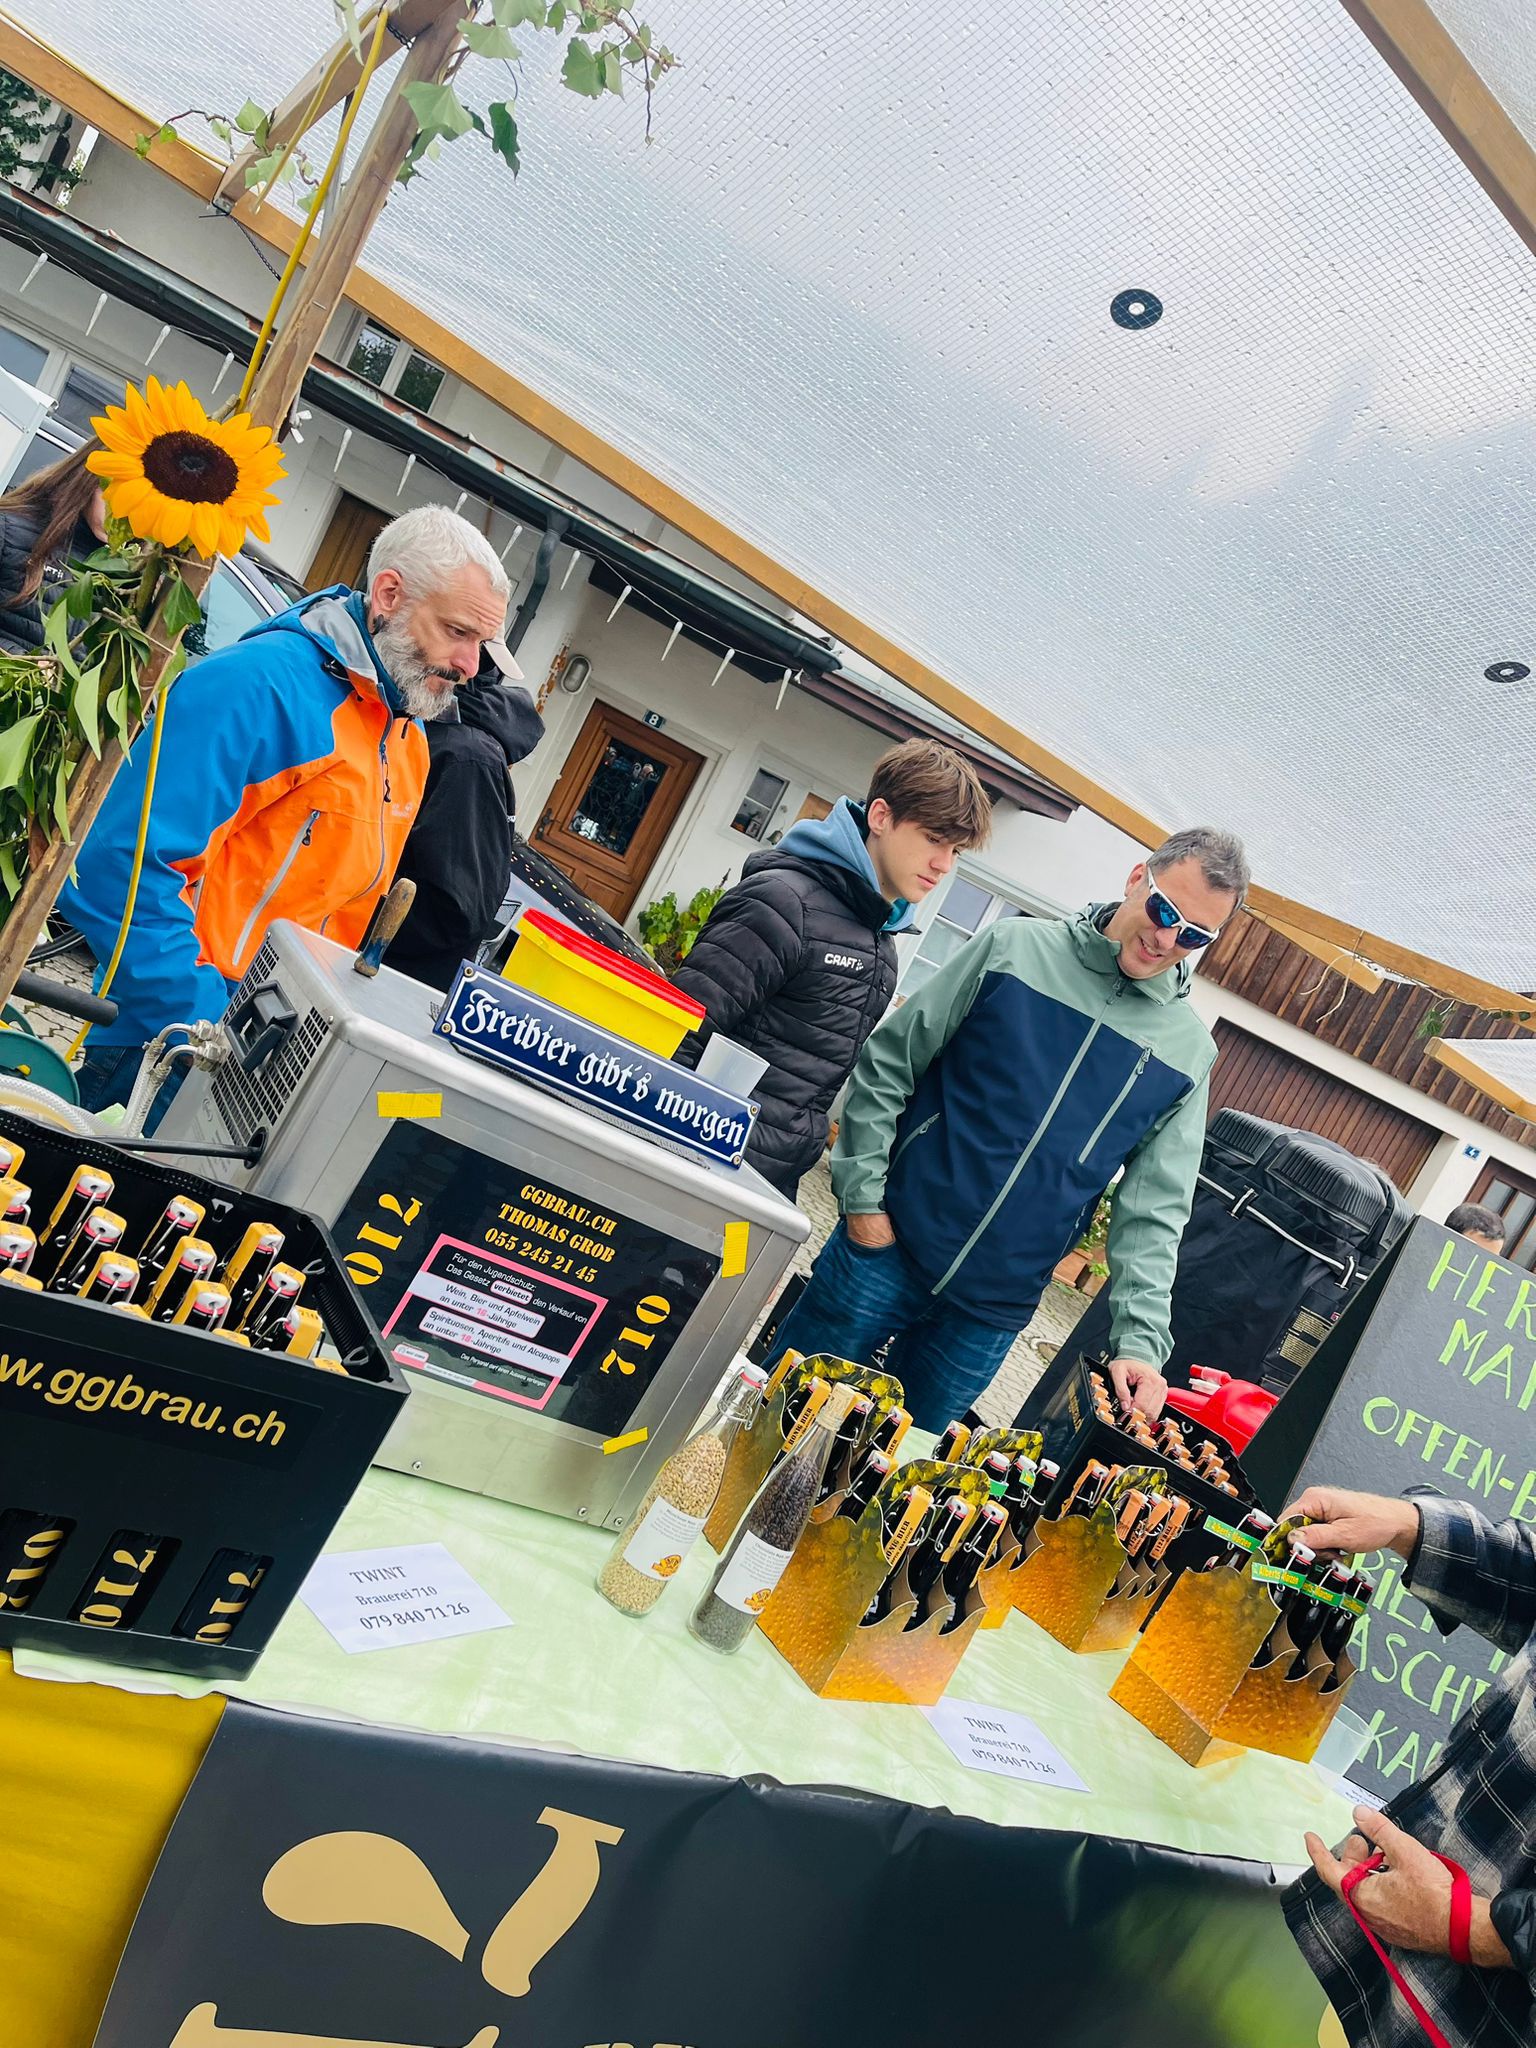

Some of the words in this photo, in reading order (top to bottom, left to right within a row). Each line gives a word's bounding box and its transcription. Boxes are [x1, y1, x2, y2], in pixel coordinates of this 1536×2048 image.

[649, 714, 660, 727] 8
[824, 953, 857, 969] CRAFT
[461, 987, 577, 1067] Freibier
[653, 1087, 746, 1148] morgen
[520, 1184, 618, 1236] GGBRAU.CH
[498, 1203, 571, 1244] THOMAS
[568, 1234, 617, 1264] GROB
[484, 1227, 520, 1251] 055
[518, 1241, 553, 1265] 245
[551, 1254, 575, 1275] 21
[575, 1265, 599, 1284] 45
[452, 1252, 468, 1264] Für
[467, 1259, 483, 1271] den
[483, 1265, 537, 1293] Jugendschutz:
[440, 1296, 451, 1304] an
[450, 1299, 474, 1312] unter
[445, 1263, 463, 1276] Das
[463, 1270, 491, 1288] Gesetz
[493, 1282, 531, 1302] verbietet
[532, 1298, 547, 1310] den
[548, 1302, 576, 1319] Verkauf
[574, 1315, 588, 1325] von
[446, 1284, 468, 1300] Wein,
[470, 1293, 488, 1305] Bier
[488, 1300, 504, 1312] und
[504, 1307, 541, 1327] Apfelwein
[423, 1321, 435, 1329] an
[435, 1325, 459, 1338] unter
[429, 1310, 475, 1335] Spirituosen,
[477, 1328, 511, 1347] Aperitifs
[511, 1341, 527, 1352] und
[527, 1346, 561, 1365] Alcopops
[600, 1294, 672, 1376] 710
[1438, 1317, 1536, 1412] MA
[800, 1407, 813, 1425] BIER
[897, 1520, 910, 1543] BIER
[79, 1549, 158, 1627] 710
[349, 1565, 407, 1584] TWINT
[354, 1588, 413, 1606] Brauerei
[411, 1584, 438, 1599] 710
[359, 1613, 393, 1631] 079
[392, 1609, 426, 1626] 840
[424, 1605, 447, 1621] 71
[446, 1601, 470, 1616] 26
[963, 1716, 1008, 1734] TWINT
[967, 1733, 1012, 1750] Brauerei
[1009, 1741, 1031, 1754] 710
[971, 1748, 997, 1763] 079
[996, 1753, 1022, 1768] 840
[1020, 1758, 1039, 1772] 71
[1037, 1762, 1057, 1775] 26
